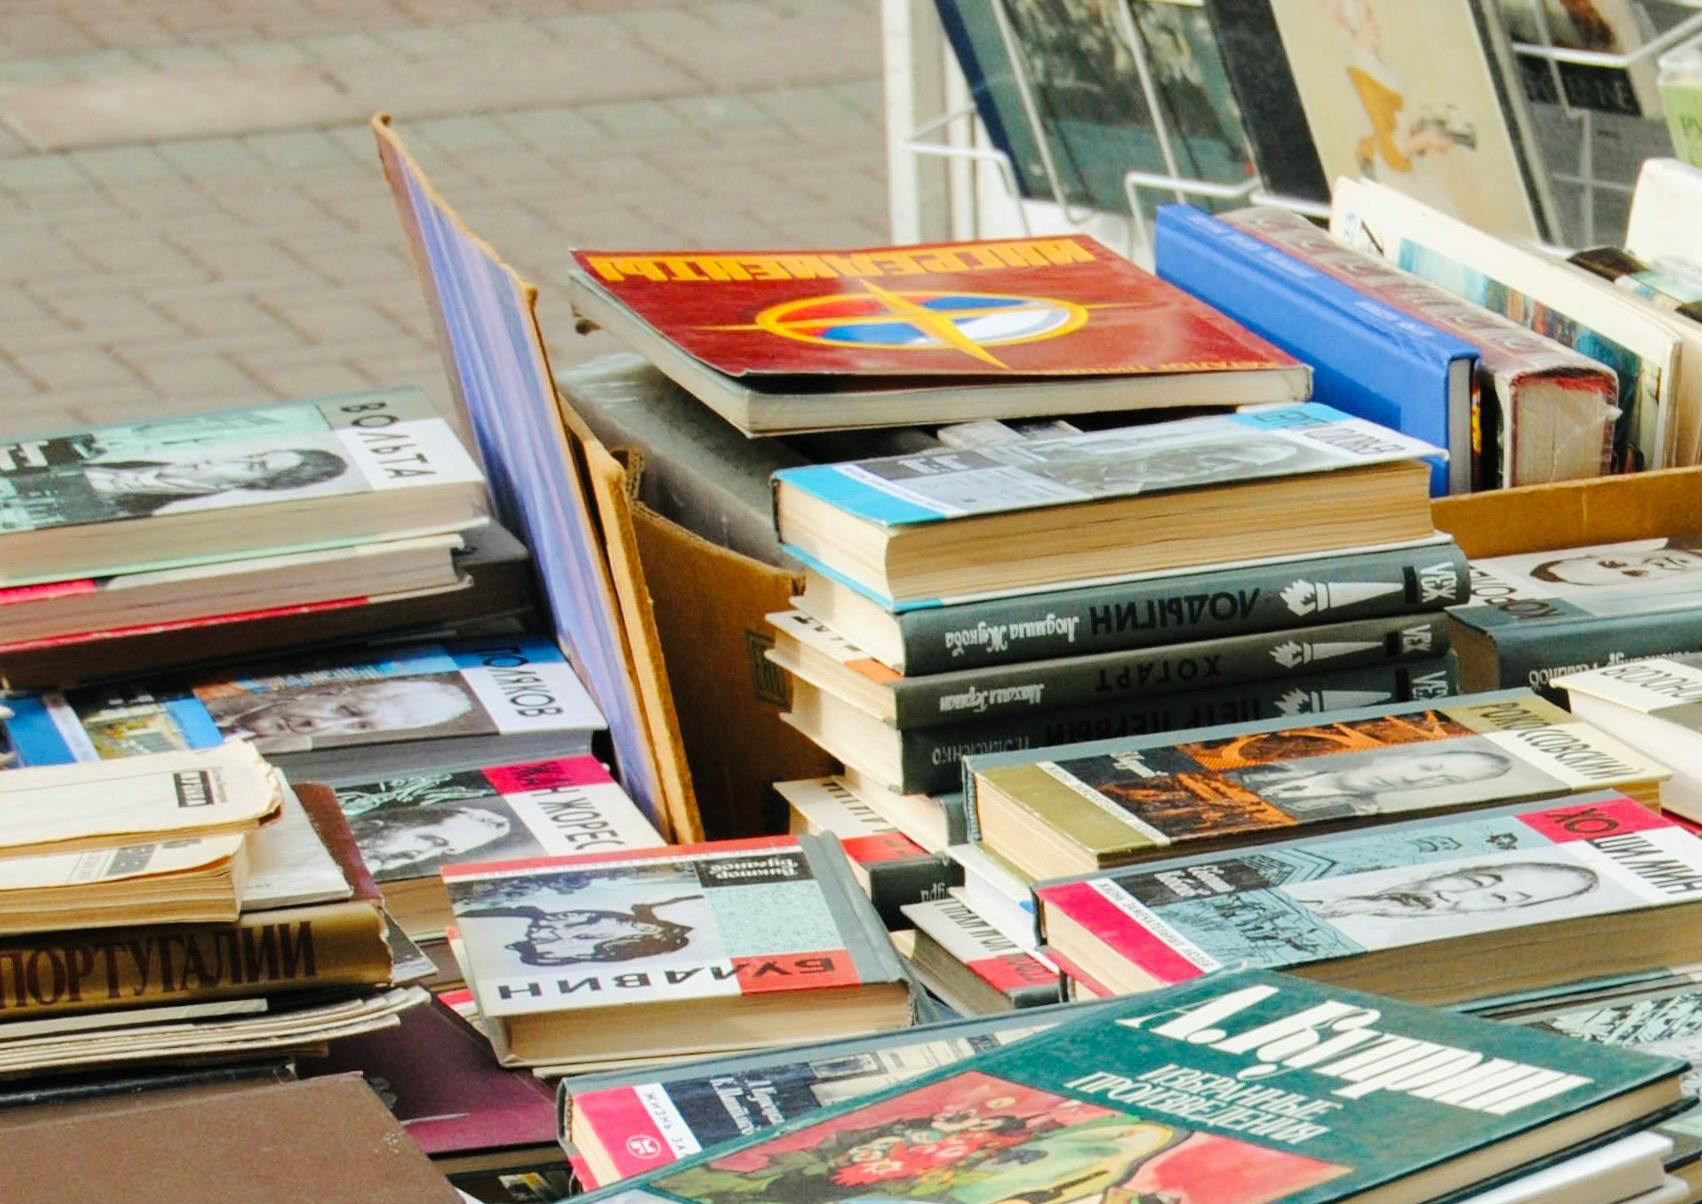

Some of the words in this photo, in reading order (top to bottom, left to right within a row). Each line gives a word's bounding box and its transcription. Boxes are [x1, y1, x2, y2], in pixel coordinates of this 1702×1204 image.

[589, 238, 1096, 282] ИНГРЕДИЕНТЫ
[340, 401, 437, 479] ВОЛЬТА
[945, 620, 1008, 656] Жукова
[1009, 613, 1080, 642] Людмила
[1089, 587, 1262, 637] ЛОДЫГИН
[472, 645, 565, 718] ПОЛЯКОВ
[1093, 655, 1221, 692] ХОГАРТ
[1481, 701, 1643, 782] РОКОССОВСКИЙ
[548, 791, 625, 852] ЖОРЕС
[0, 921, 317, 1008] ПОРТУГАЛИИ
[499, 956, 836, 1000] БУЛАВИН
[1065, 1071, 1331, 1144] ПРОИЗВЕДЕНИЯ
[1137, 1063, 1344, 1122] ИЗБРАННЫЕ
